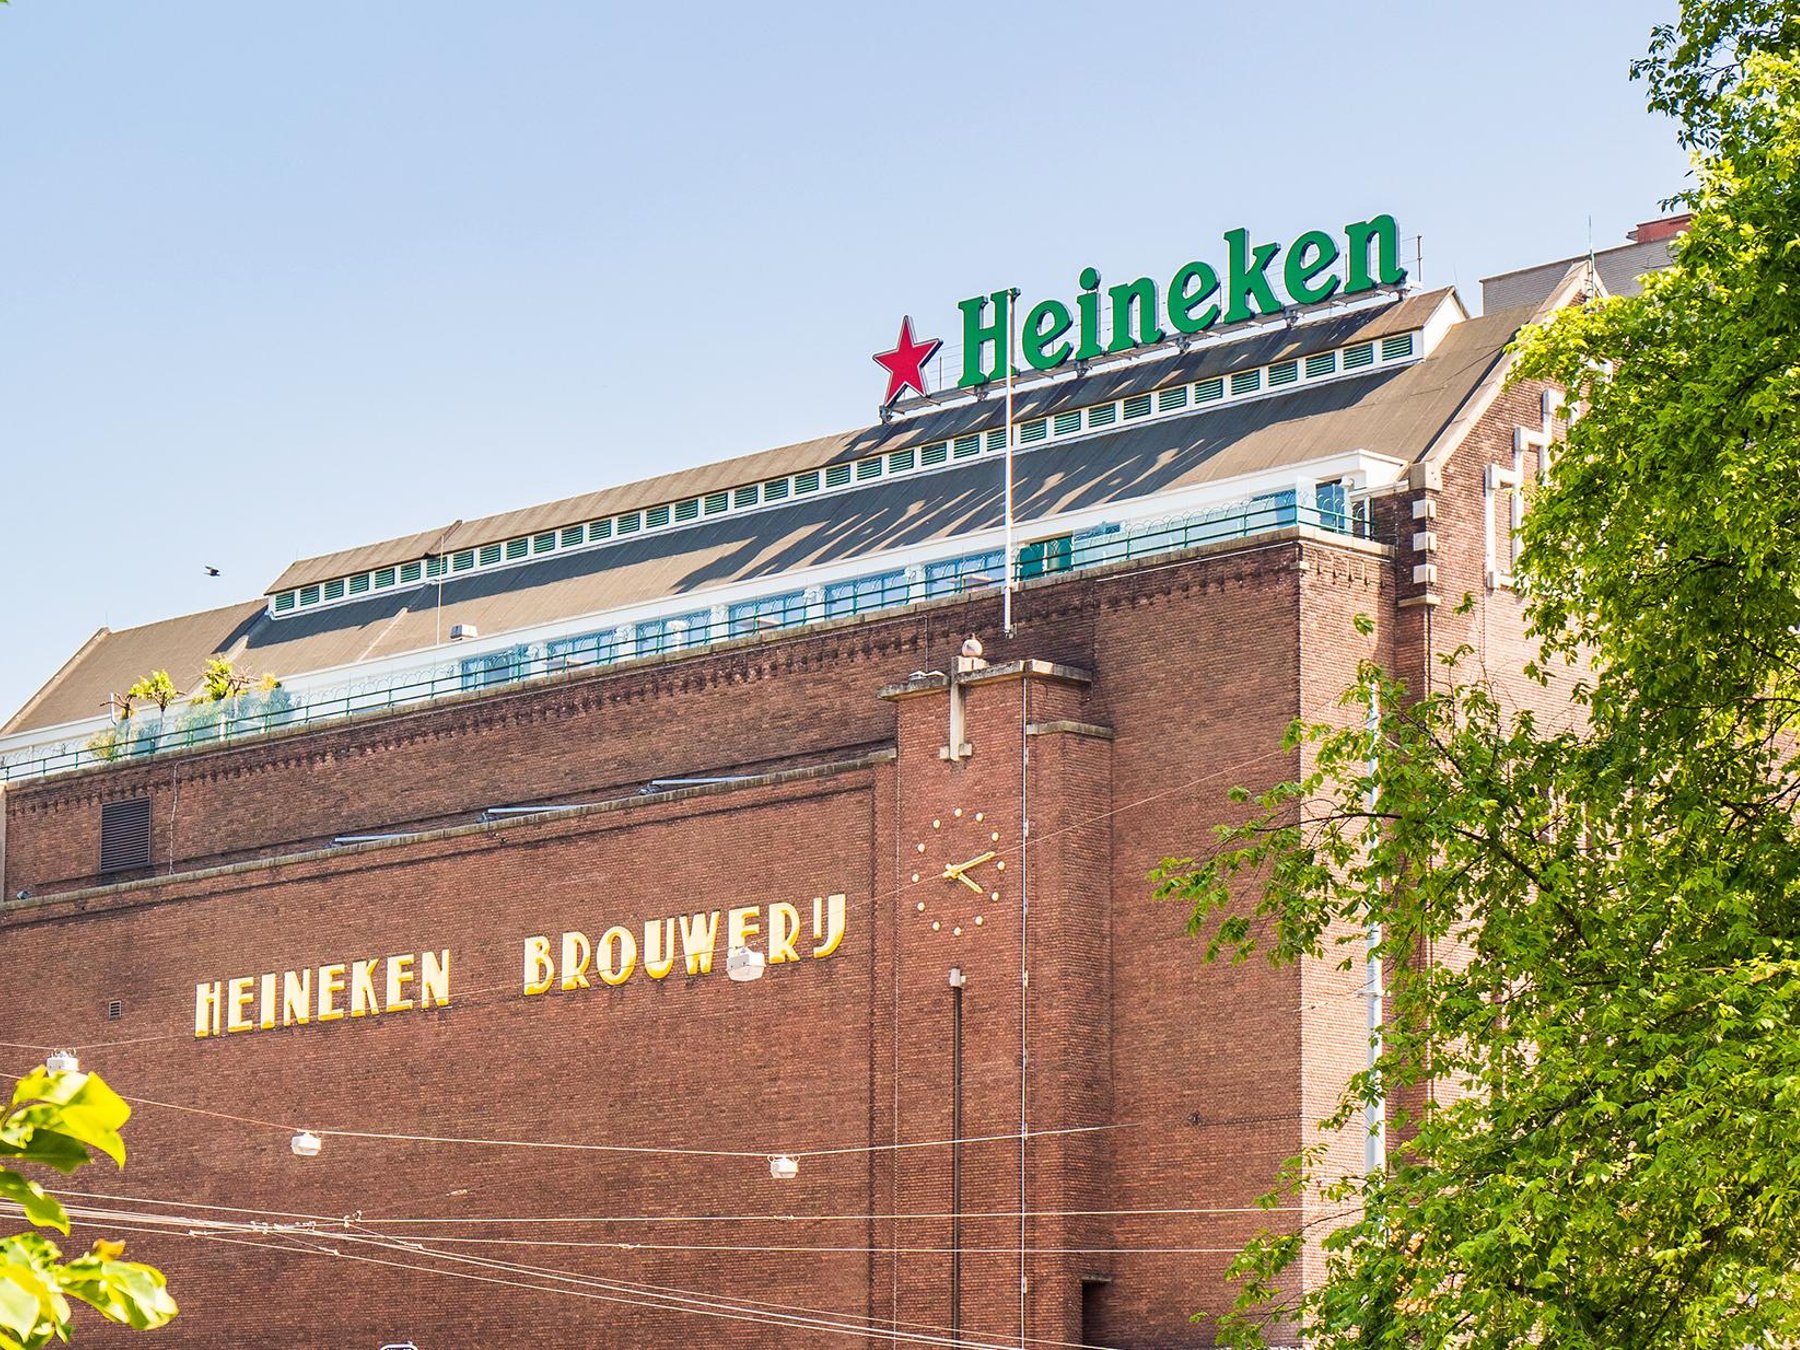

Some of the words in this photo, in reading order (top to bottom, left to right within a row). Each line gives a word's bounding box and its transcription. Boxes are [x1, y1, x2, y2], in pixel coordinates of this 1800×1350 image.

[957, 213, 1407, 388] Heineken
[194, 948, 450, 1038] HEINEKEN
[523, 893, 846, 996] BROUWERIJ
